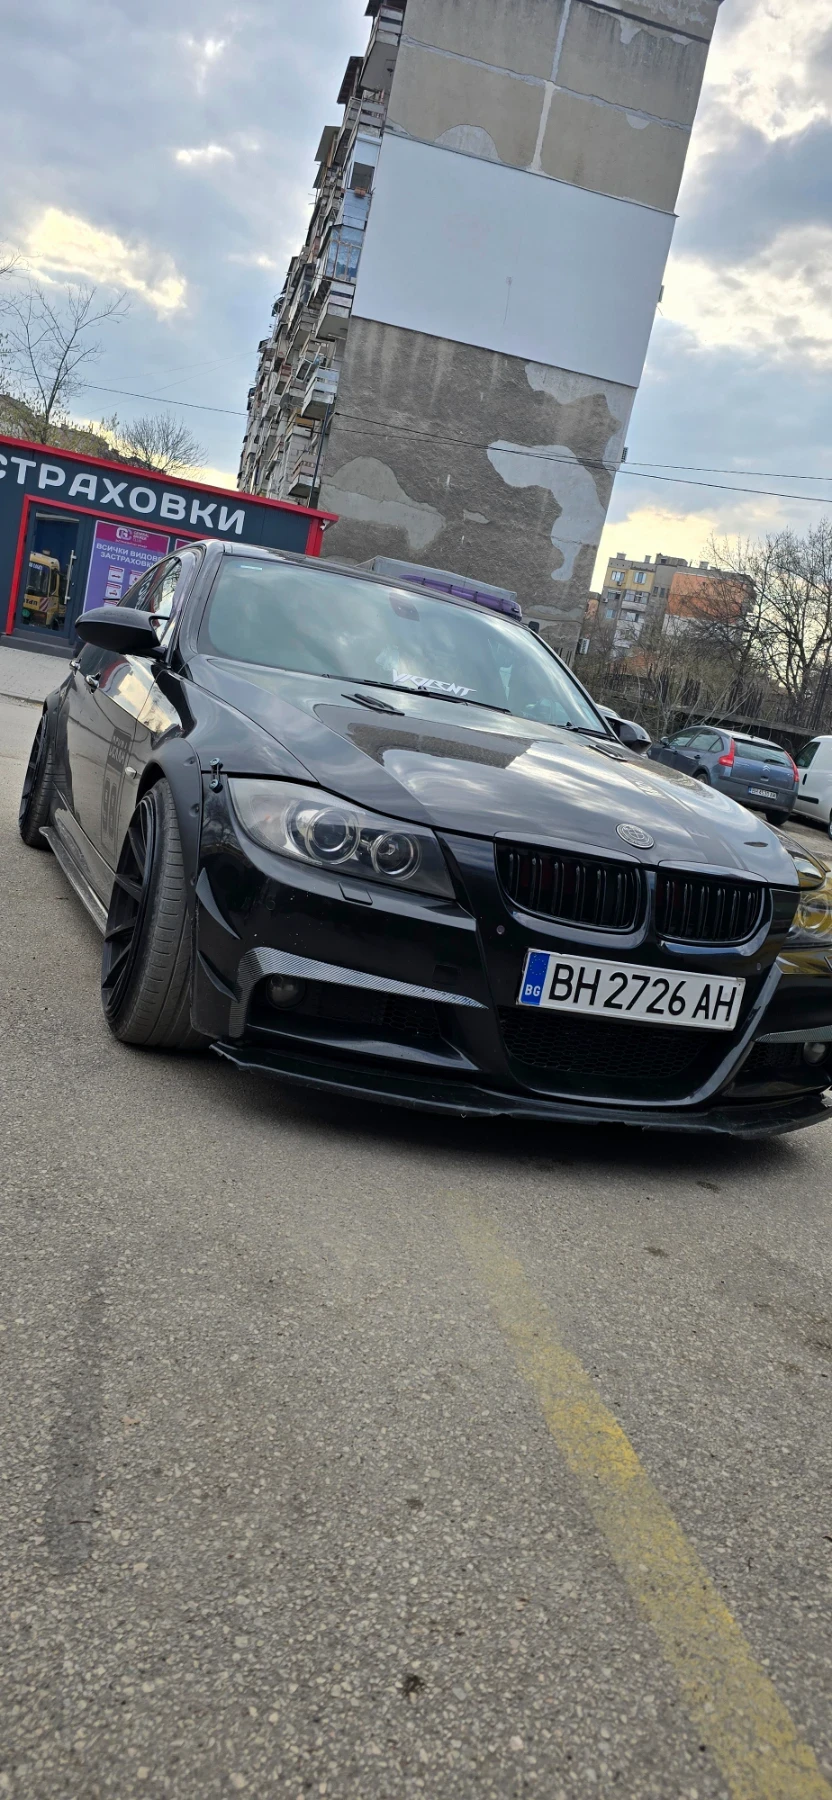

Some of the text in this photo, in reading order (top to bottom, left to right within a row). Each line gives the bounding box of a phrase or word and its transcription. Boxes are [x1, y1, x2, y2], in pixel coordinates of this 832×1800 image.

[96, 542, 129, 556] ВСИЧКИ
[525, 984, 540, 997] BG
[548, 963, 738, 1022] BH 2726 AH
